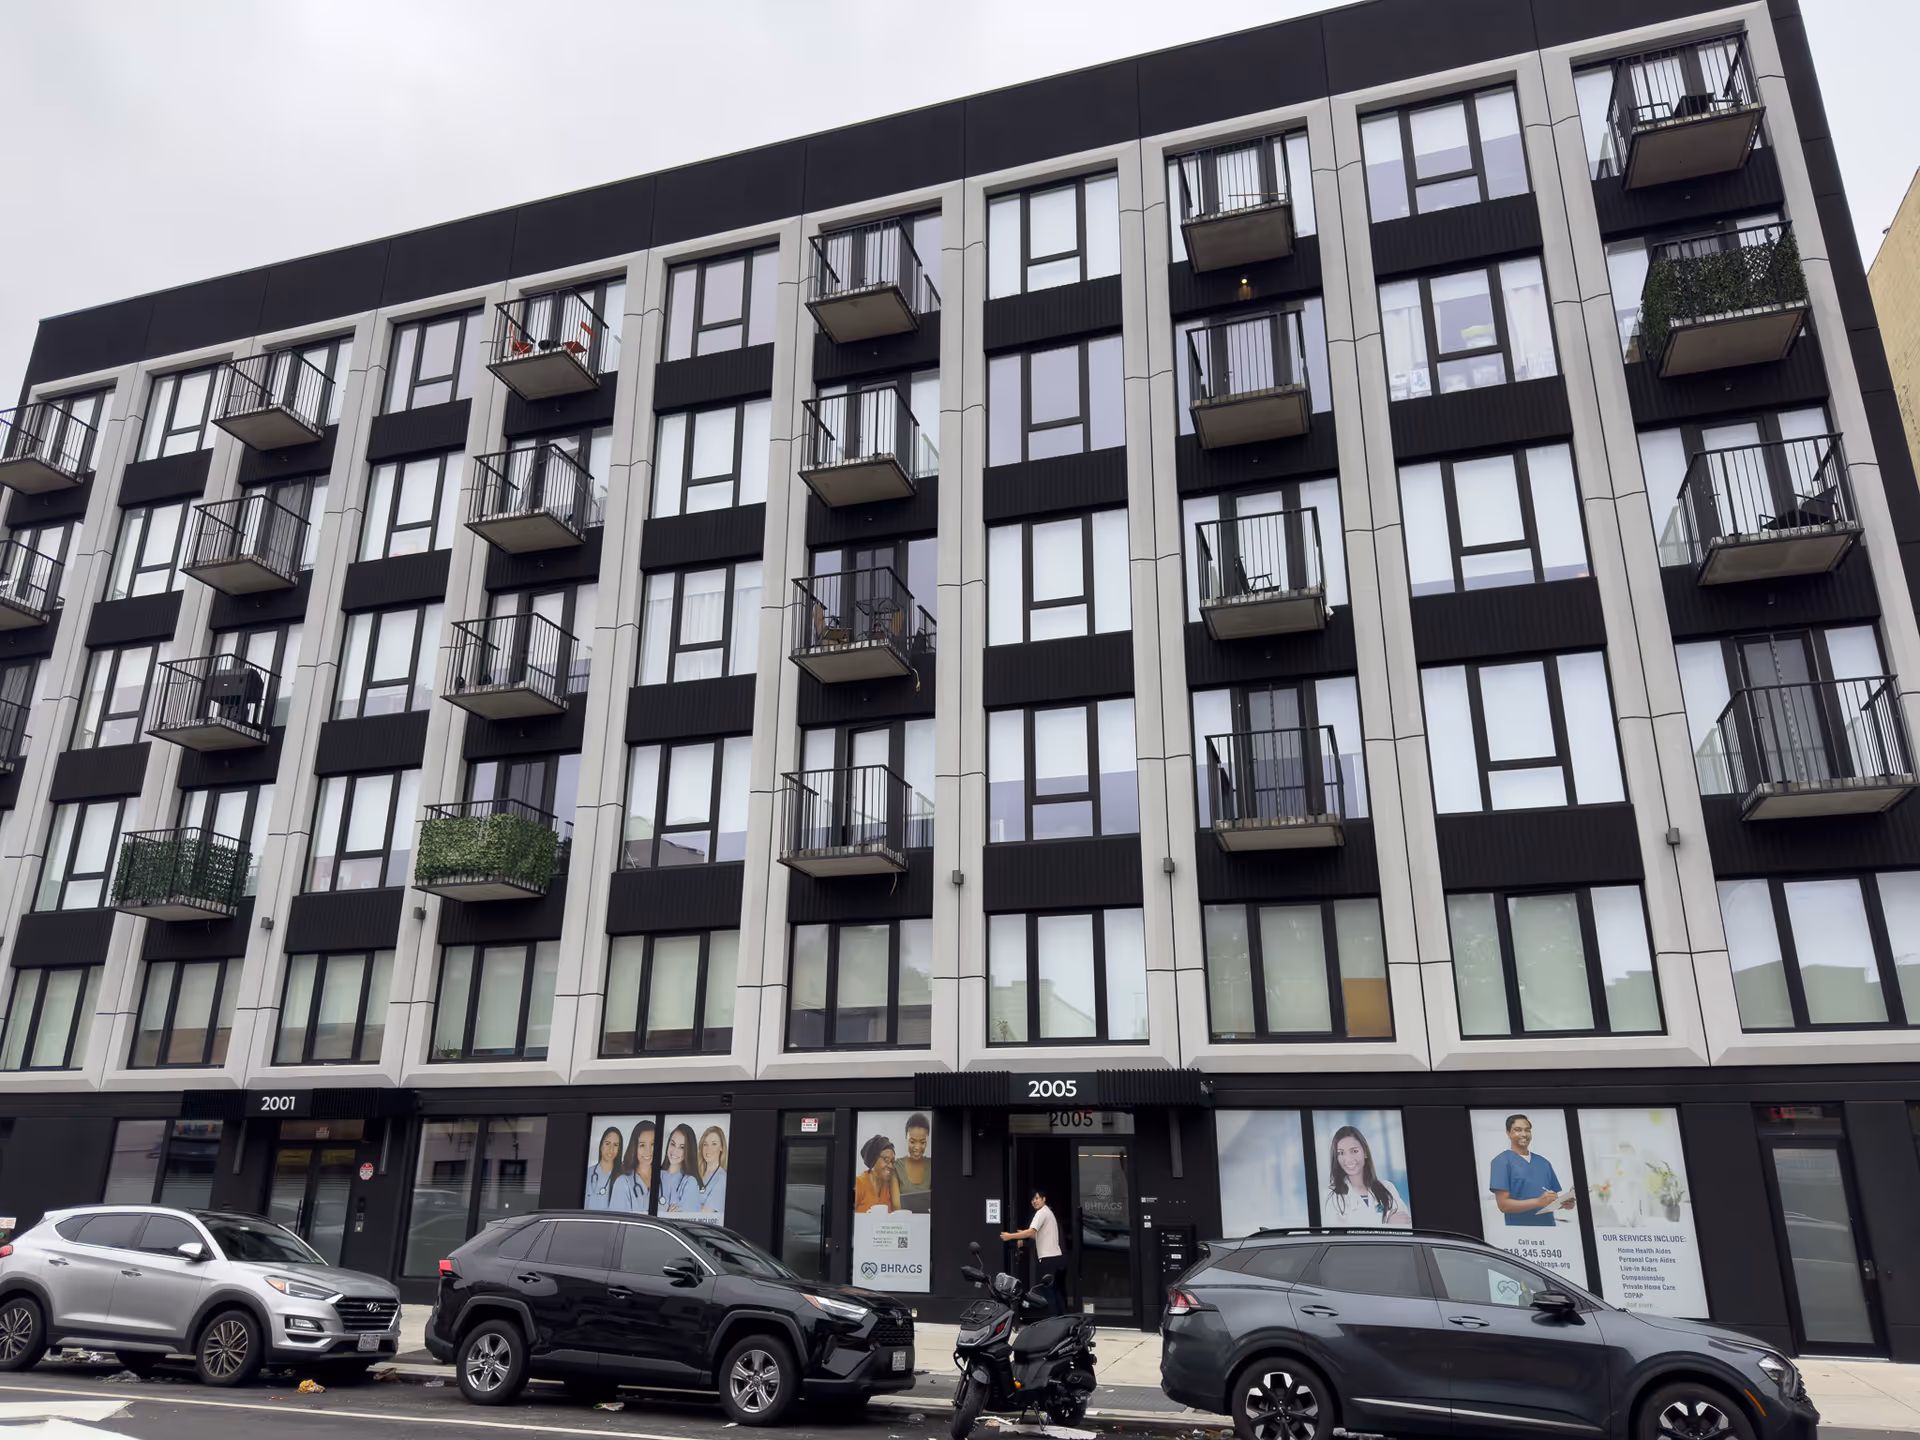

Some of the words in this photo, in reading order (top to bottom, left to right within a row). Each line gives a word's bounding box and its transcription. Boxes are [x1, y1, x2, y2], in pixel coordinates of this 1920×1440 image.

[1028, 1080, 1077, 1097] 2005
[261, 1096, 295, 1110] 2001
[1049, 1111, 1093, 1127] 2005
[1619, 1234, 1652, 1242] SERVICES
[1654, 1235, 1687, 1243] INCLUDE:
[881, 1264, 922, 1273] BHRAGS
[1621, 1274, 1665, 1282] Companionship
